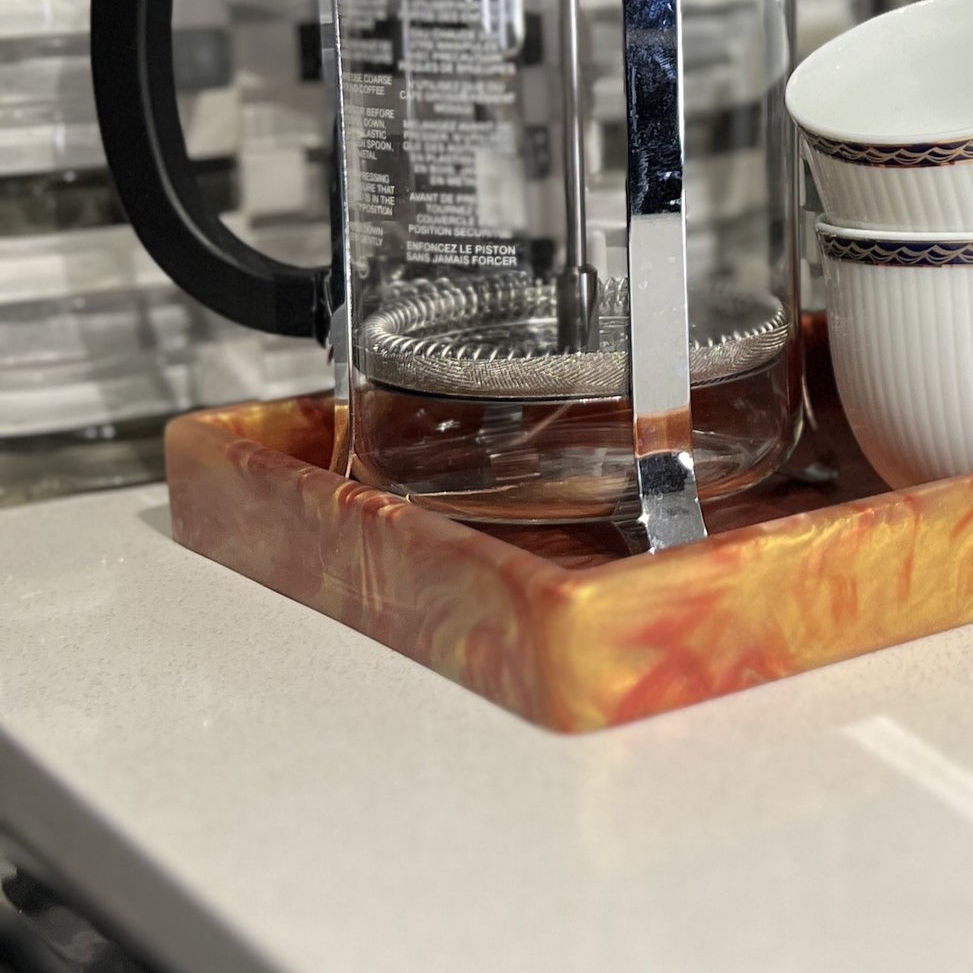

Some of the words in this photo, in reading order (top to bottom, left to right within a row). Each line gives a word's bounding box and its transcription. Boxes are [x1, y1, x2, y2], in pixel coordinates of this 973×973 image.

[364, 74, 392, 85] COARSE
[359, 84, 385, 95] COFFEE
[366, 107, 395, 119] BEFORE
[377, 184, 395, 194] THAT
[380, 195, 395, 206] THE
[409, 192, 438, 202] AVANT
[408, 224, 452, 236] POSITION
[407, 241, 457, 253] ENFONCEZ
[460, 244, 472, 254] LE
[475, 244, 516, 255] PISTON
[406, 252, 430, 262] SANS
[432, 254, 470, 265] JAMAIS
[472, 256, 517, 266] FORCER
